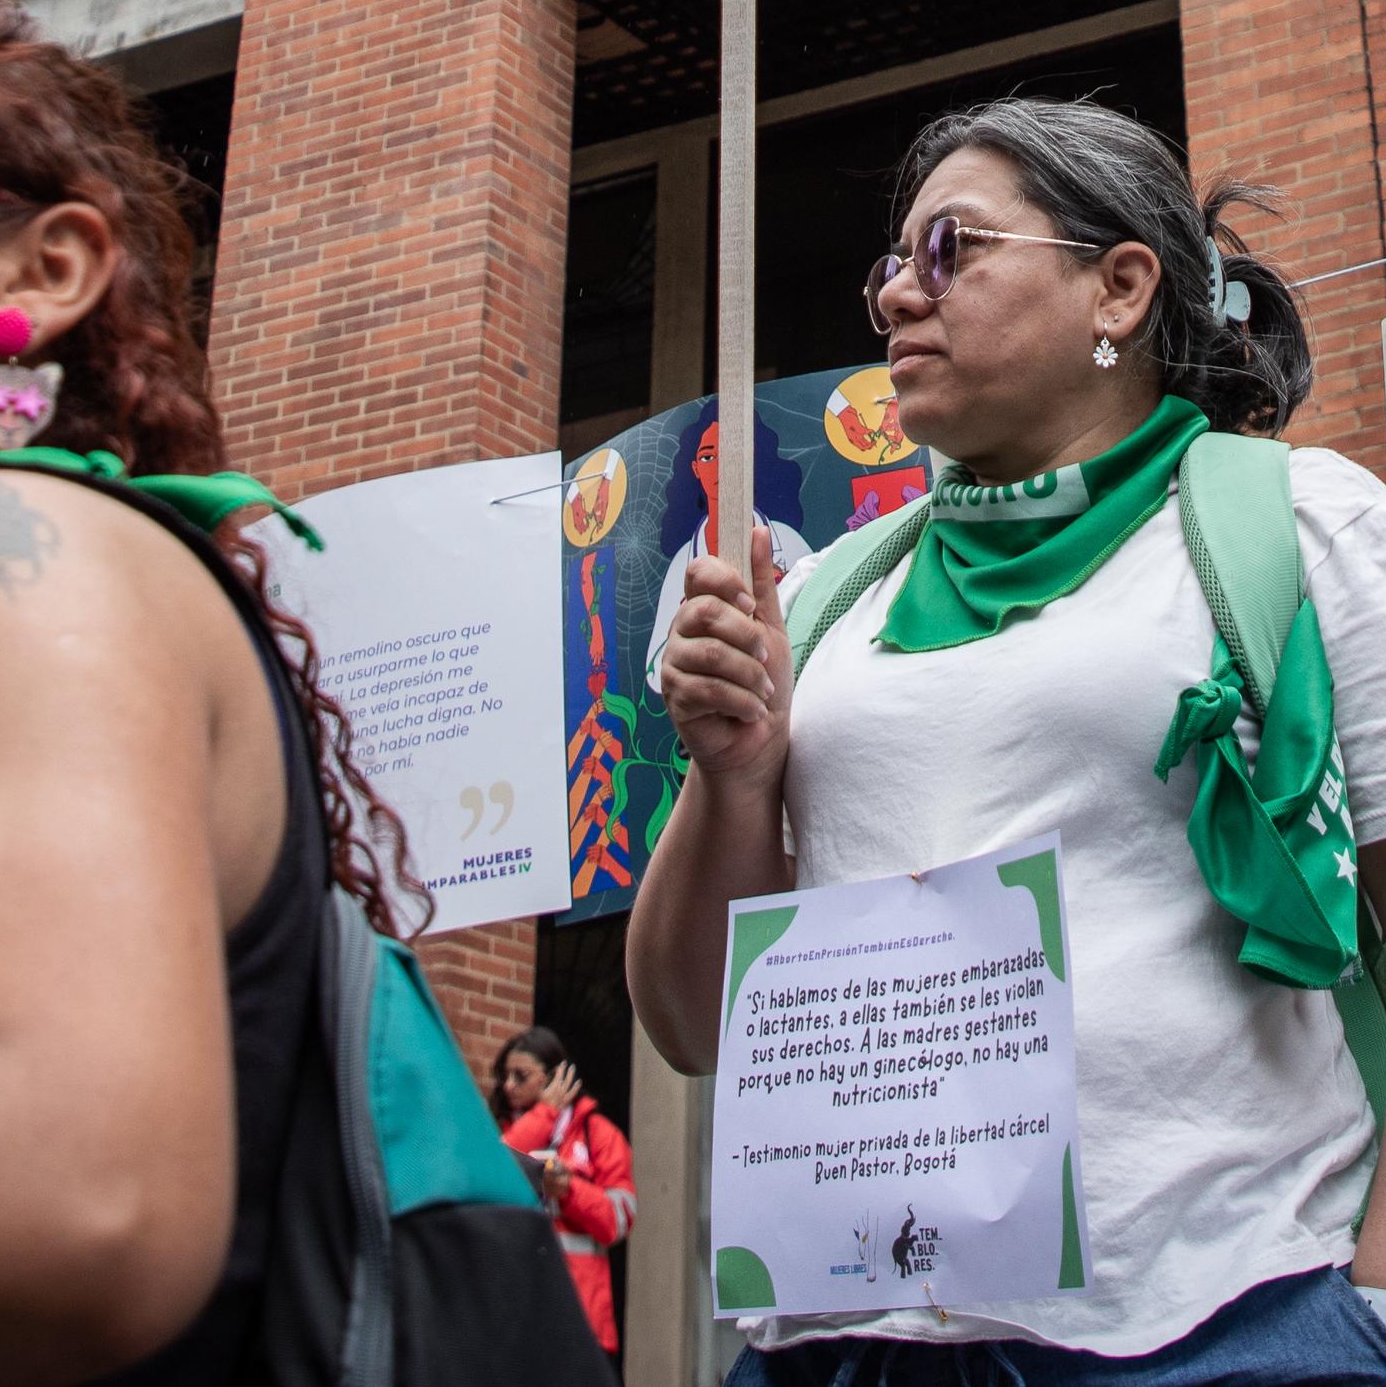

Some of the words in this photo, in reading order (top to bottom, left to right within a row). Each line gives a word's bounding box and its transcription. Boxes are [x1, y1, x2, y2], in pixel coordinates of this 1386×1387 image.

[339, 640, 402, 665] remolino
[406, 629, 457, 648] oscuro
[460, 623, 491, 640] que
[347, 654, 428, 682] usurparme
[449, 644, 479, 662] que
[370, 669, 443, 696] depresión
[370, 698, 400, 715] veía
[404, 686, 465, 708] incapaz
[382, 714, 424, 733] lucha
[427, 705, 476, 723] digna.
[379, 733, 421, 754] había
[425, 723, 469, 744] nadie
[463, 847, 533, 871] MUJERES
[769, 986, 838, 1010] hablamos
[842, 978, 861, 1000] de
[866, 977, 887, 999] las
[892, 971, 956, 994] mujeres
[961, 946, 1045, 984] embarazadas
[852, 1003, 887, 1025] ellas
[892, 992, 955, 1021] también
[960, 994, 976, 1012] se
[980, 986, 1000, 1009] les
[1005, 976, 1044, 1003] violan
[752, 1046, 775, 1065] sus
[779, 1033, 855, 1060] derechos.
[876, 1028, 898, 1050] las
[902, 1021, 960, 1045] madres
[964, 1006, 1037, 1042] gestantes
[738, 1071, 792, 1098] porque
[796, 1068, 815, 1085] no
[819, 1060, 845, 1085] hay
[850, 1061, 868, 1078] un
[972, 1047, 991, 1064] no
[995, 1037, 1020, 1063] hay
[1024, 1034, 1048, 1055] una
[743, 1143, 811, 1168] Testimonio
[815, 1140, 855, 1158] mujer
[858, 1130, 909, 1159] privada
[913, 1128, 931, 1148] de
[934, 1127, 946, 1147] la
[950, 1119, 1006, 1146] libertad
[1009, 1112, 1049, 1138] cárcel
[815, 1161, 847, 1185] Buen
[903, 1147, 956, 1177] Bogotá
